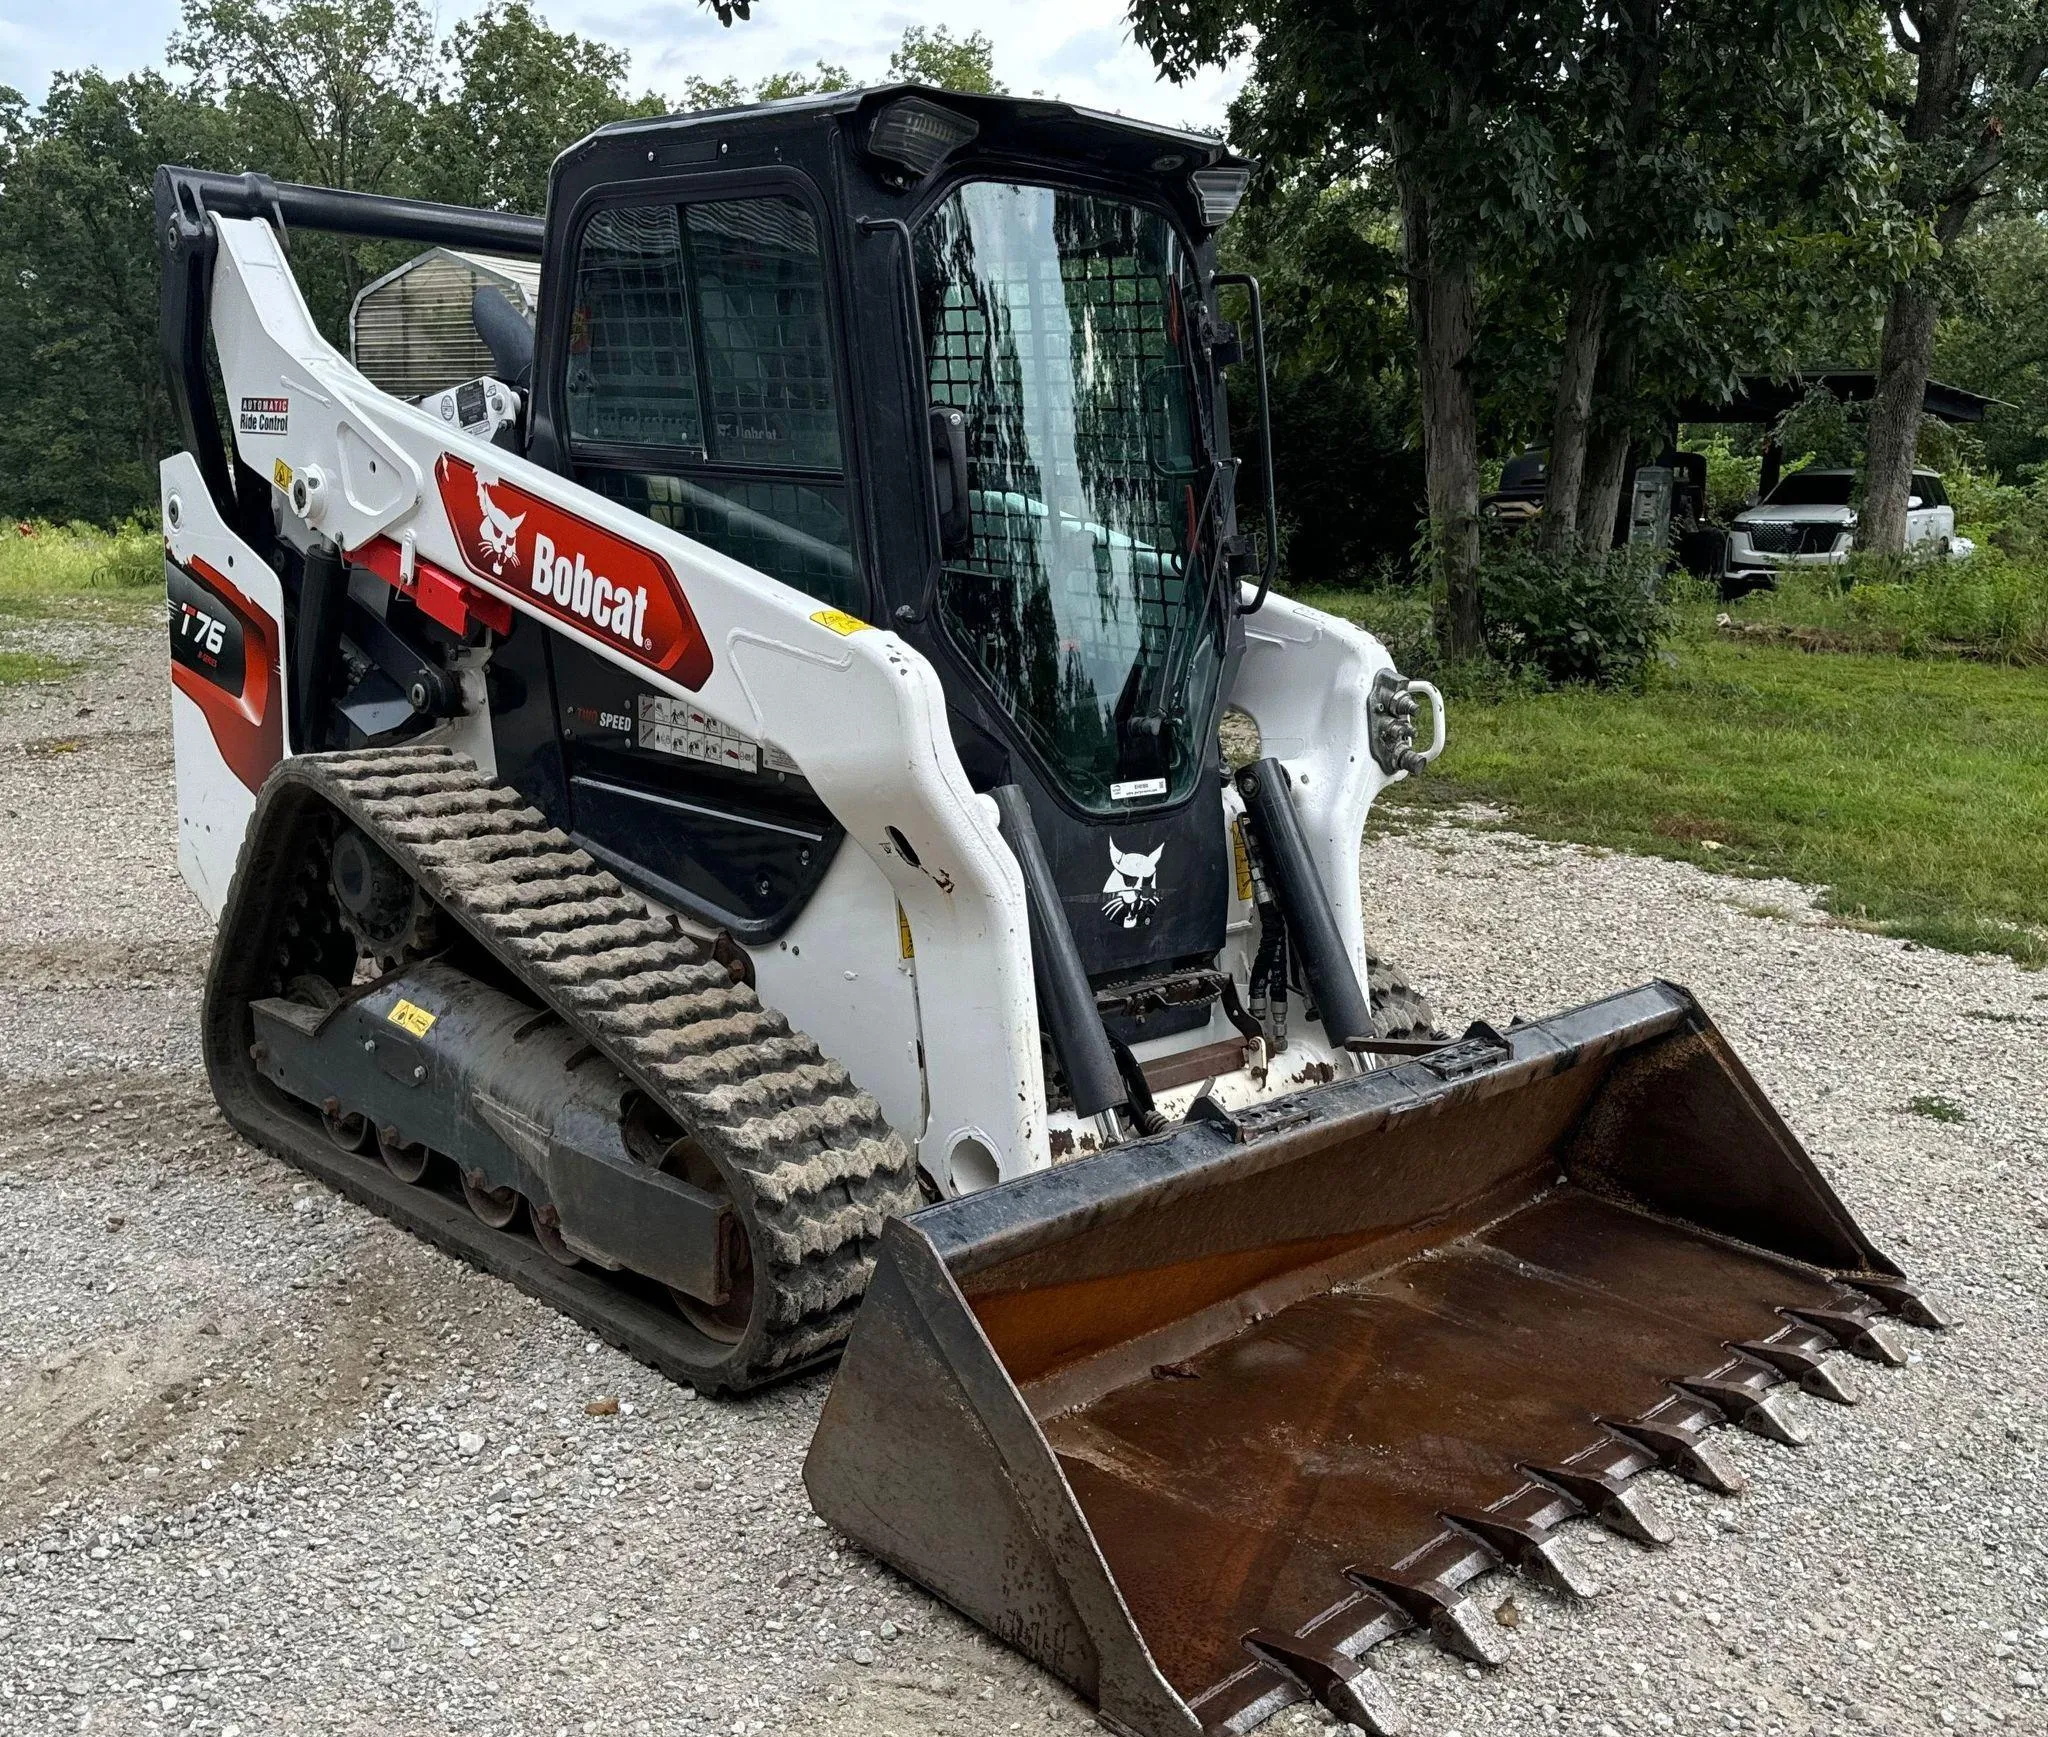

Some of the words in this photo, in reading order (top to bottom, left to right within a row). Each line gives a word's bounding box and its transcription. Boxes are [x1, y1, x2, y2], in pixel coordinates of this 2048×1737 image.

[242, 399, 288, 411] AUTOMATIC
[240, 413, 257, 430] Ride
[259, 414, 288, 431] Control
[531, 532, 648, 648] Bobcat
[181, 602, 226, 655] T76
[599, 711, 632, 732] SPEED
